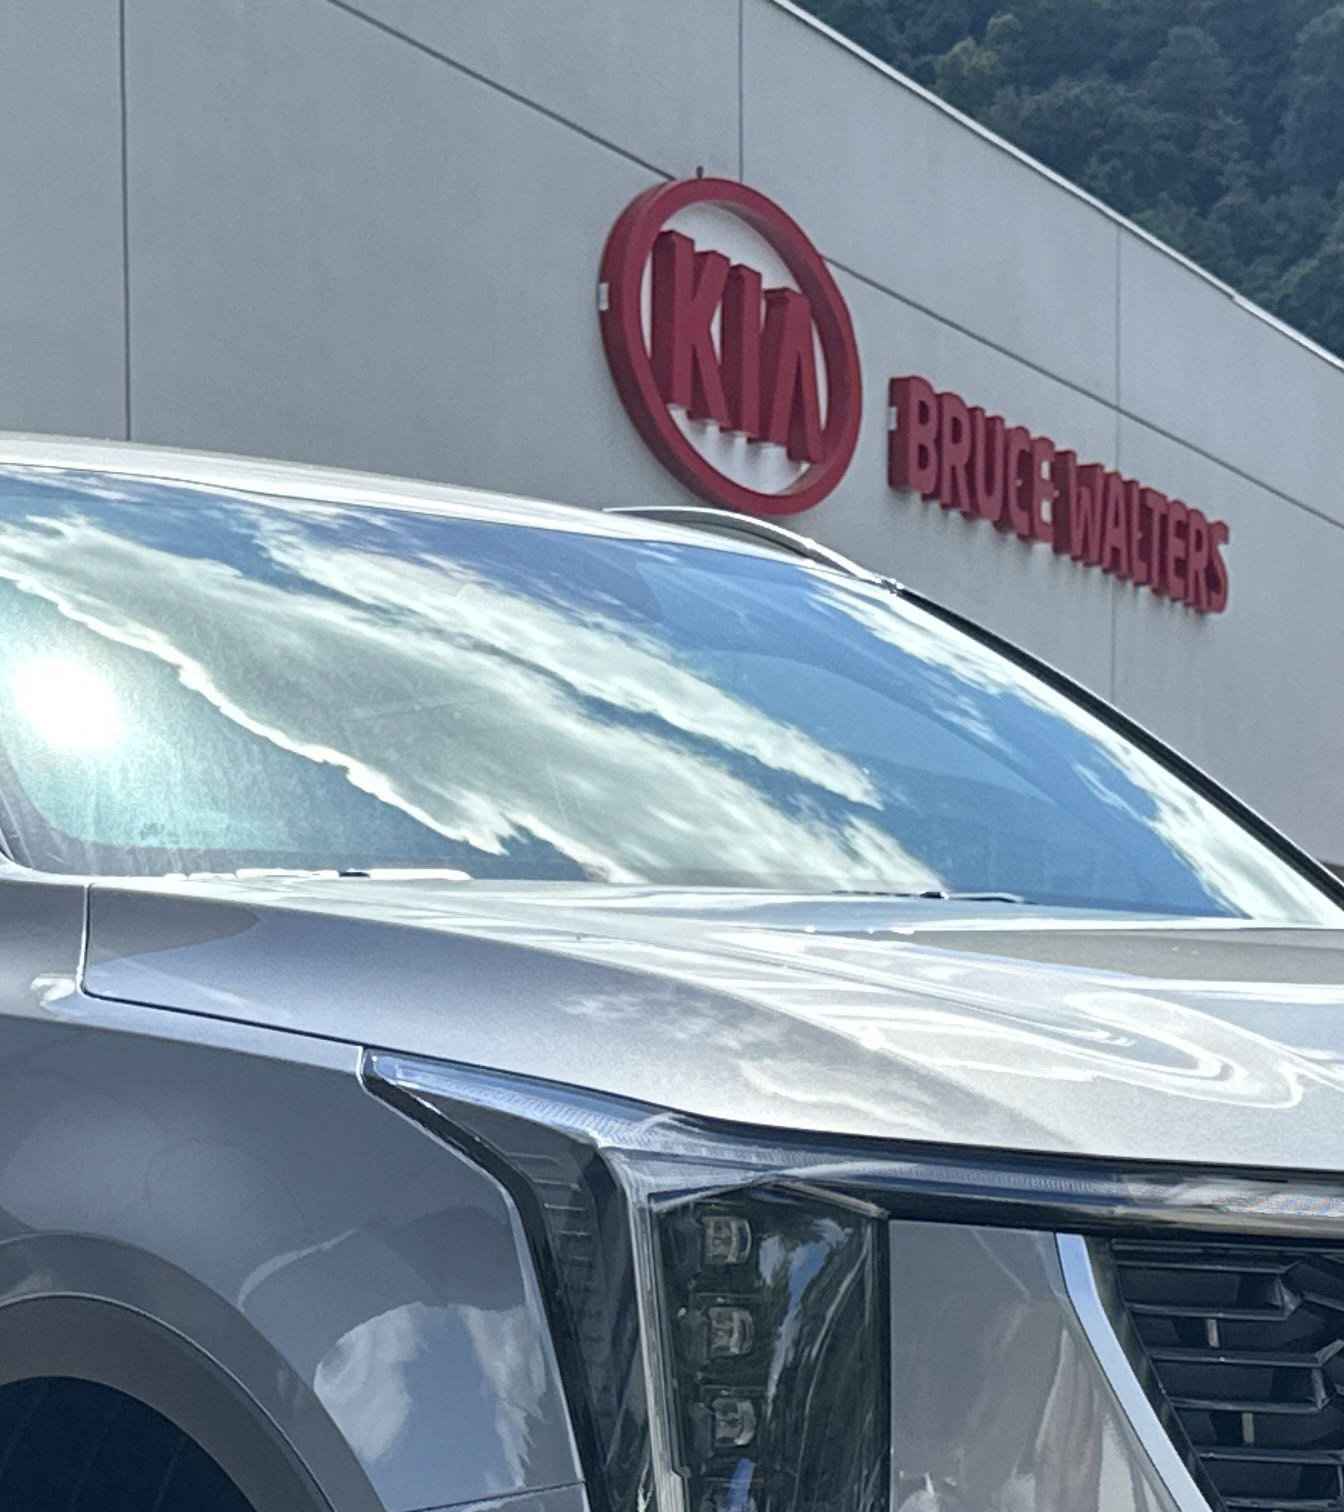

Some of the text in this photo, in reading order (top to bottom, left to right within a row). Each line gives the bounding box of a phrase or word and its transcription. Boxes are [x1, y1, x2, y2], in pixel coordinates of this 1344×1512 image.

[652, 230, 823, 463] KIA
[888, 375, 1229, 614] BRUCE WALTERS
